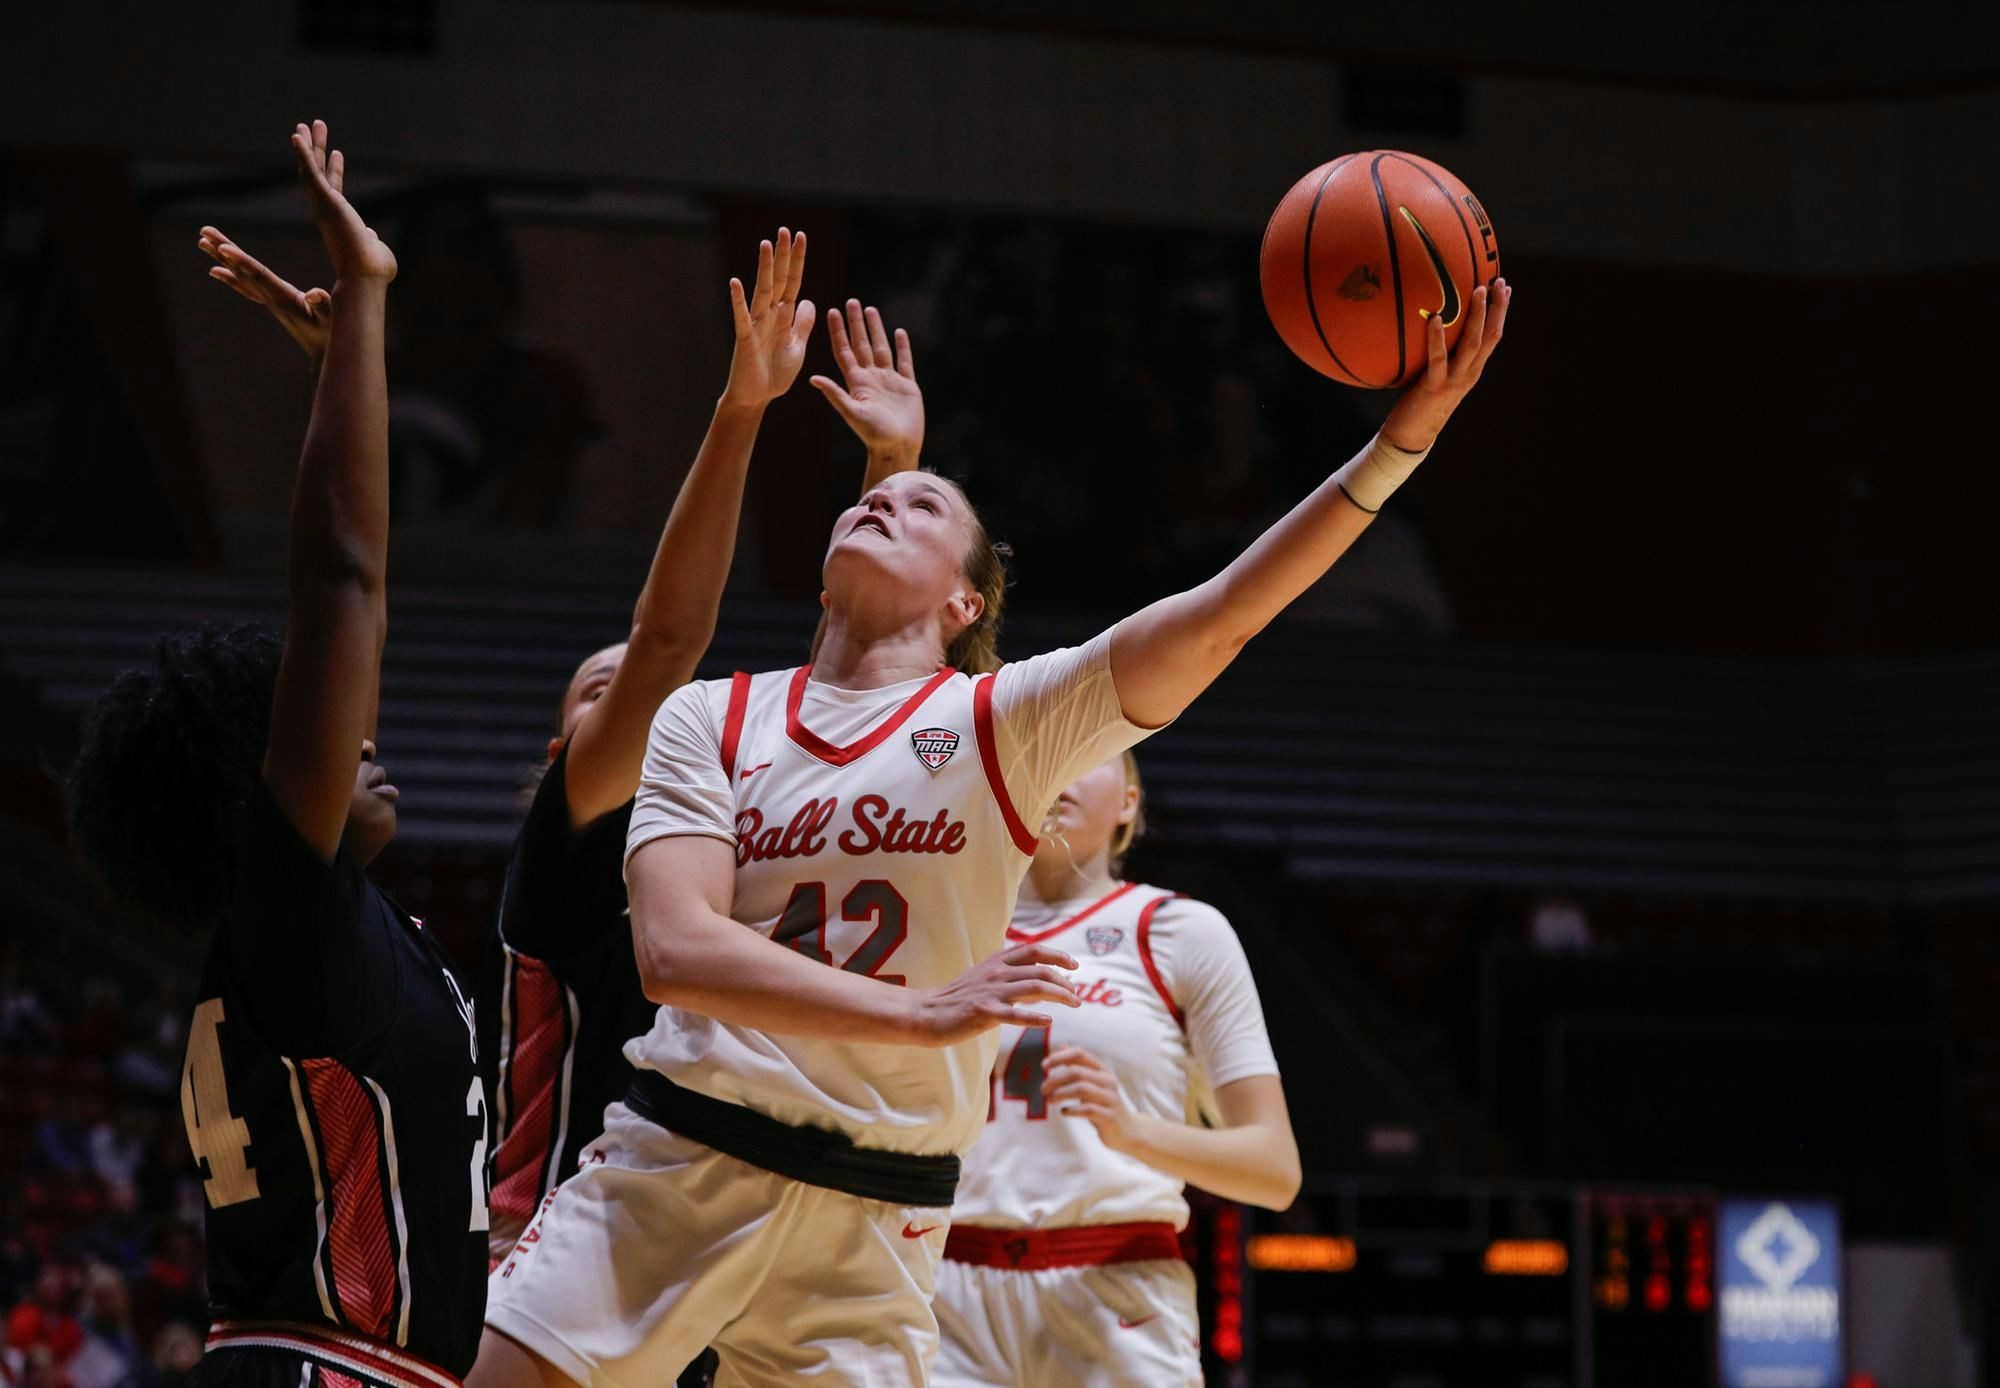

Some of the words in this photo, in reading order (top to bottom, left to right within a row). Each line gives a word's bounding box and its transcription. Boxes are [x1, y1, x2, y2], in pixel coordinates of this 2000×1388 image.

[914, 739, 958, 753] MAC
[735, 796, 838, 869] Ball
[838, 793, 967, 856] State
[769, 879, 908, 987] 42
[1074, 978, 1123, 1007] ate
[180, 995, 262, 1211] 4
[986, 1025, 1051, 1122] 4
